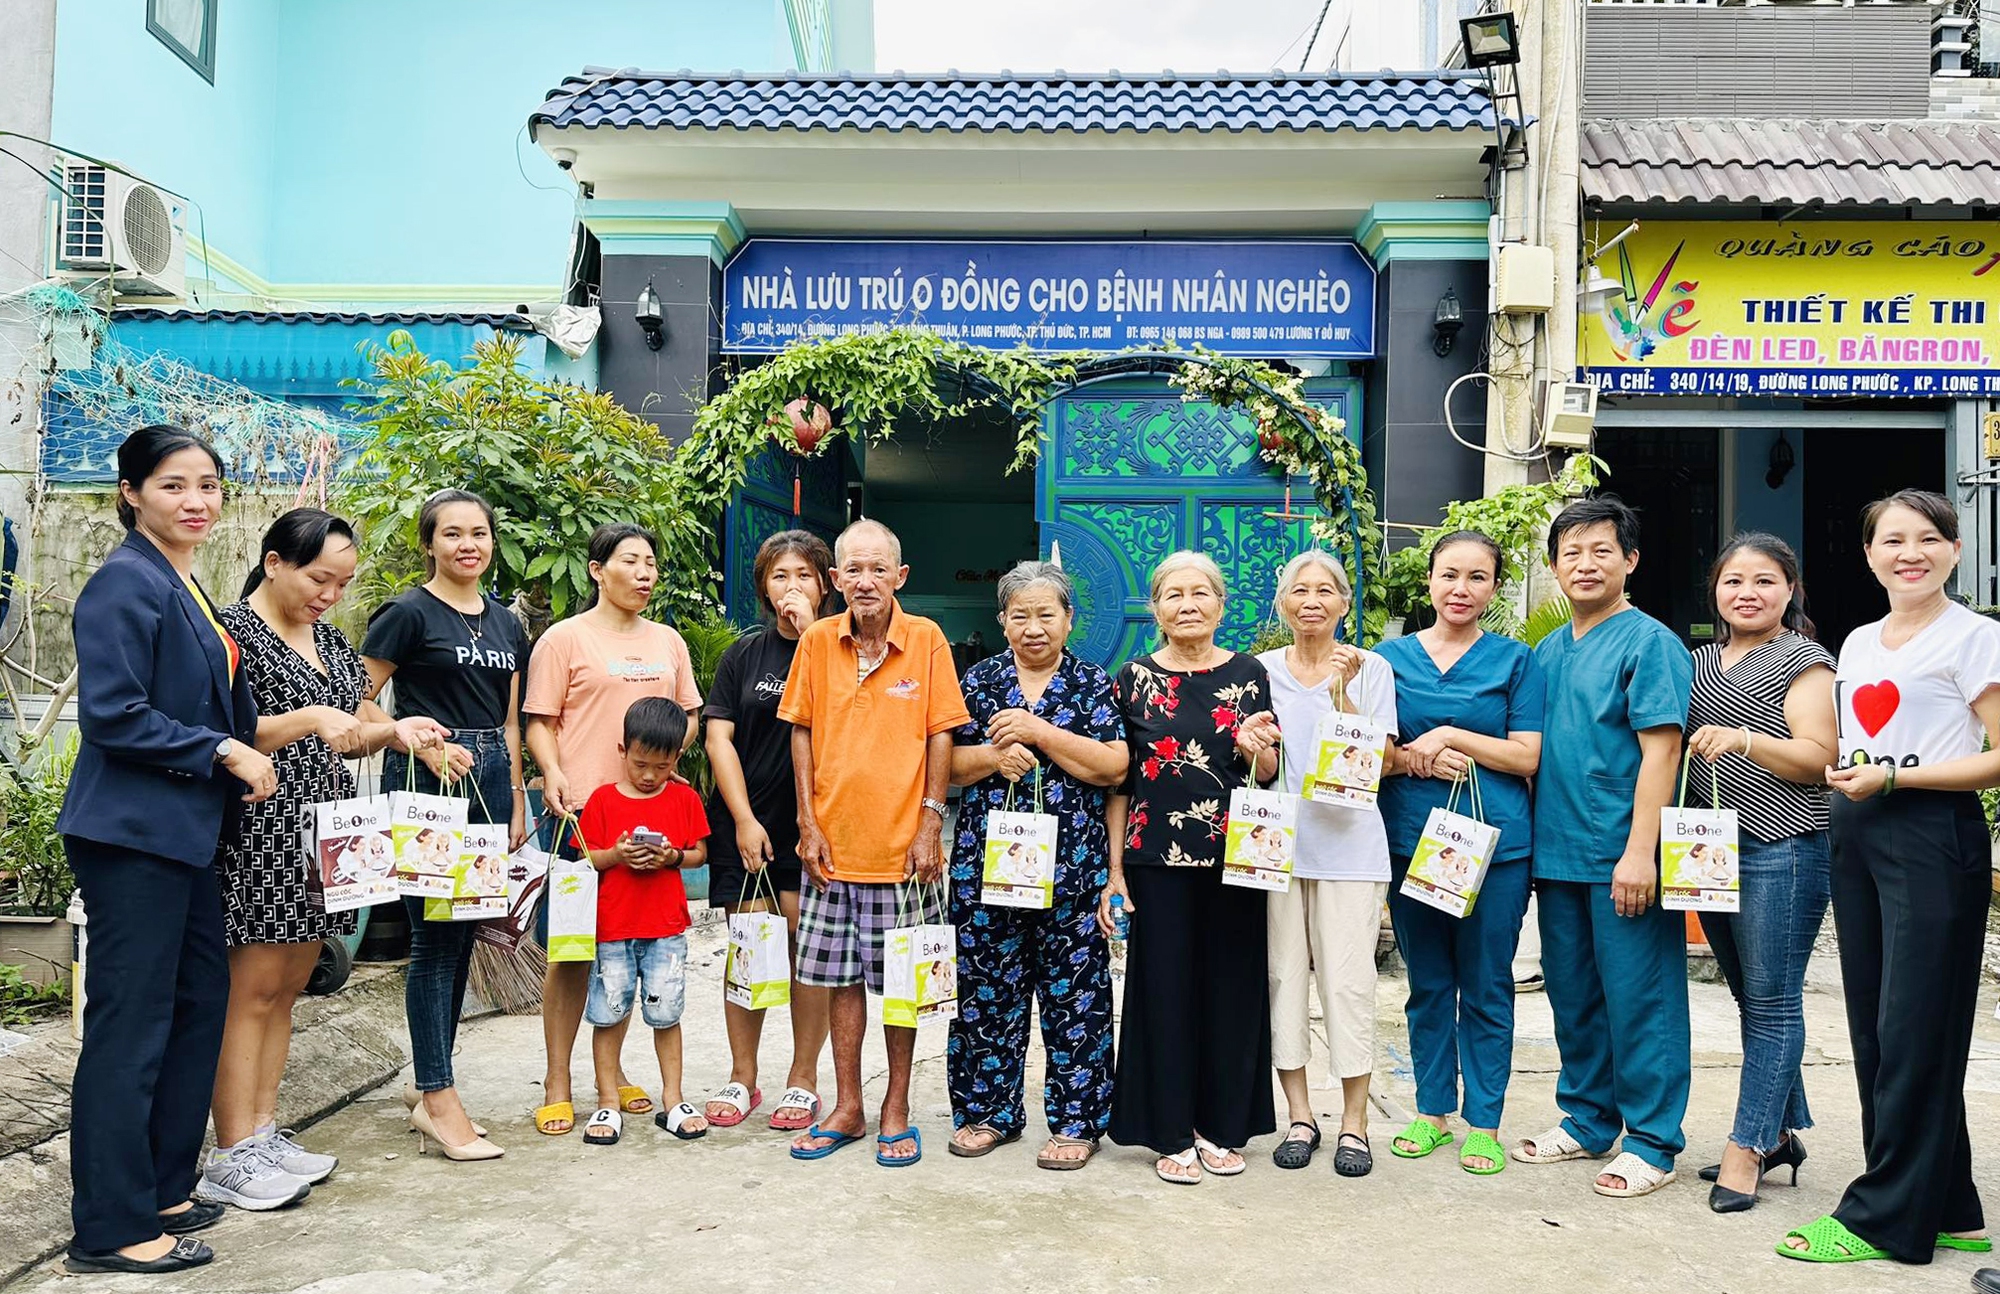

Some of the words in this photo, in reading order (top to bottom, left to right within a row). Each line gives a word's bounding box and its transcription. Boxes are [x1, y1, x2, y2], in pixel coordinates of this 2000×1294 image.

[1892, 236, 1985, 257] CÁO
[742, 266, 797, 310] NHÀ
[806, 272, 850, 310] LƯU
[859, 266, 903, 311] TRÚ
[941, 259, 1020, 312] ĐỒNG
[1028, 277, 1089, 312] CHO
[1097, 268, 1163, 322] BỆNH
[1172, 269, 1246, 313] NHÂN
[1256, 268, 1350, 314] NGHÈO
[1742, 294, 1848, 323] THIẾT
[1863, 294, 1915, 323] KẾ
[1929, 301, 1985, 324] THI
[962, 324, 970, 337] P.
[971, 325, 993, 337] LONG
[1079, 326, 1091, 338] TP.
[1092, 326, 1112, 338] HCM
[1140, 326, 1160, 339] 0965
[1162, 326, 1176, 339] 146
[1178, 327, 1193, 339] 068
[1194, 327, 1206, 339] BS
[1207, 327, 1224, 339] NGA
[1231, 327, 1250, 339] 0989
[1252, 327, 1268, 339] 500
[1269, 327, 1284, 339] 479
[1314, 327, 1321, 340] Y
[1334, 328, 1351, 340] HUY
[1690, 334, 1752, 361] ĐÈN
[1763, 339, 1826, 365] LED,
[1840, 335, 1990, 366] BĂNGRON,
[1620, 368, 1655, 390] CHỈ:
[1759, 371, 1807, 391] ĐƯỜNG
[1812, 375, 1848, 390] LONG
[1914, 375, 1937, 391] KP.
[1942, 375, 1979, 392] LONG
[455, 638, 516, 672] PARIS
